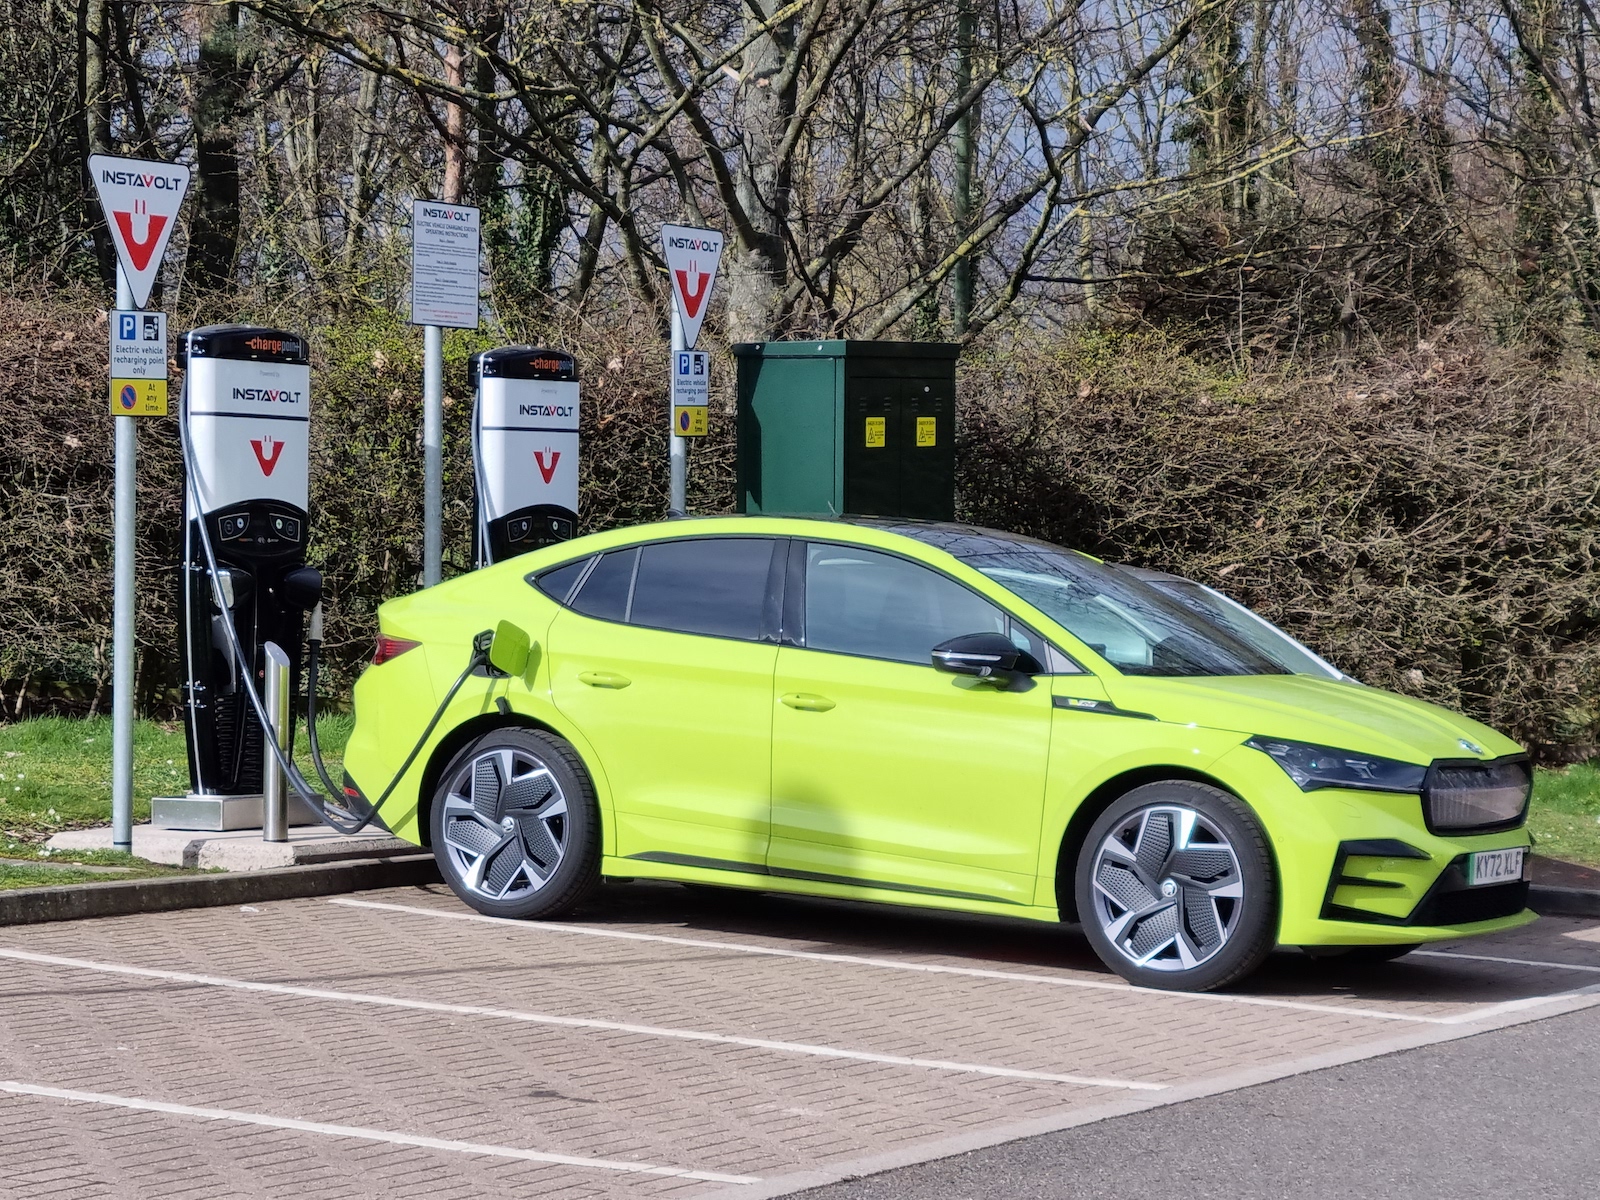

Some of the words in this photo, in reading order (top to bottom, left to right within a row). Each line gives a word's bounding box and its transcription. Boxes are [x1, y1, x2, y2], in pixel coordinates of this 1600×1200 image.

[102, 169, 182, 191] INSTAVOLT
[422, 207, 471, 222] INSTAVOLT
[669, 236, 719, 253] INSTAVOLT
[122, 316, 134, 338] P
[115, 345, 140, 354] Electric
[141, 346, 163, 355] vehicle
[114, 356, 147, 366] recharging
[148, 356, 165, 366] point
[132, 366, 147, 375] only
[148, 383, 156, 391] At
[677, 378, 692, 386] Electric
[693, 378, 707, 386] vehicle
[232, 387, 301, 404] INSTAVOLT
[676, 387, 697, 395] recharging
[146, 394, 157, 403] any
[145, 403, 159, 411] time
[519, 404, 574, 417] INSTAVOLT
[1476, 854, 1502, 879] KY72
